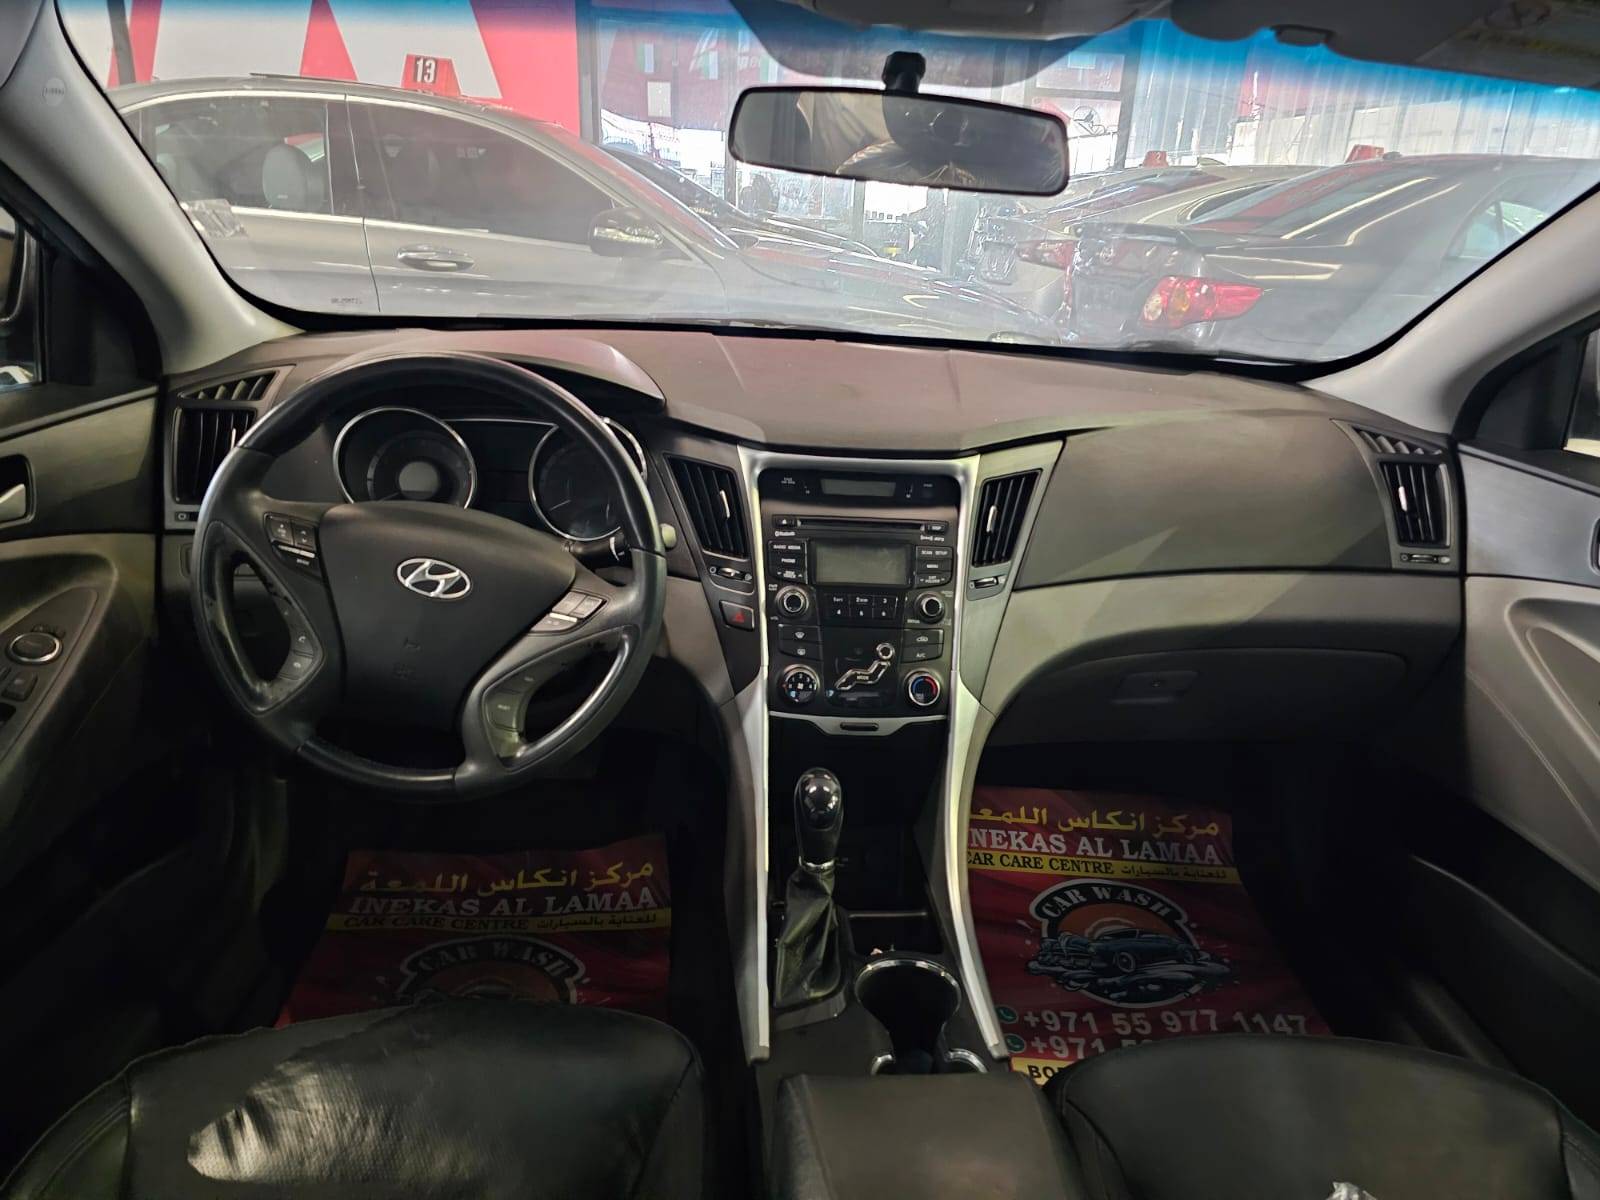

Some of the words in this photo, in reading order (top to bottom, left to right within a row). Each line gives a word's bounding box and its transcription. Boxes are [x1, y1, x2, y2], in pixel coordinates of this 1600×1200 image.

[416, 57, 436, 83] 13
[969, 805, 1048, 825] اللمع
[1057, 809, 1145, 832] انكاس
[1152, 813, 1219, 840] مركز
[968, 828, 1068, 854] NEKAS
[1076, 836, 1113, 858] AL
[1120, 839, 1224, 865] LAMAA
[584, 861, 654, 891] مركز
[1000, 853, 1044, 869] CARE
[1049, 857, 1114, 874] CENTRE
[359, 870, 469, 895] اللمعة
[477, 868, 578, 896] انكاس
[348, 896, 481, 916] INEKAS
[488, 897, 535, 917] AL
[544, 886, 658, 915] LAMAA
[1041, 888, 1088, 918] CAR
[1091, 886, 1172, 918] WASH
[343, 916, 385, 928] CAR
[391, 917, 445, 929] CARE
[451, 918, 529, 930] CENTRE
[417, 944, 478, 971] CAR
[493, 942, 572, 976] WASH
[1023, 1010, 1099, 1034] +971
[1112, 1012, 1153, 1035] 55
[1160, 1008, 1219, 1033] 977
[1232, 1011, 1308, 1035] 1147
[1031, 1035, 1105, 1060] +971
